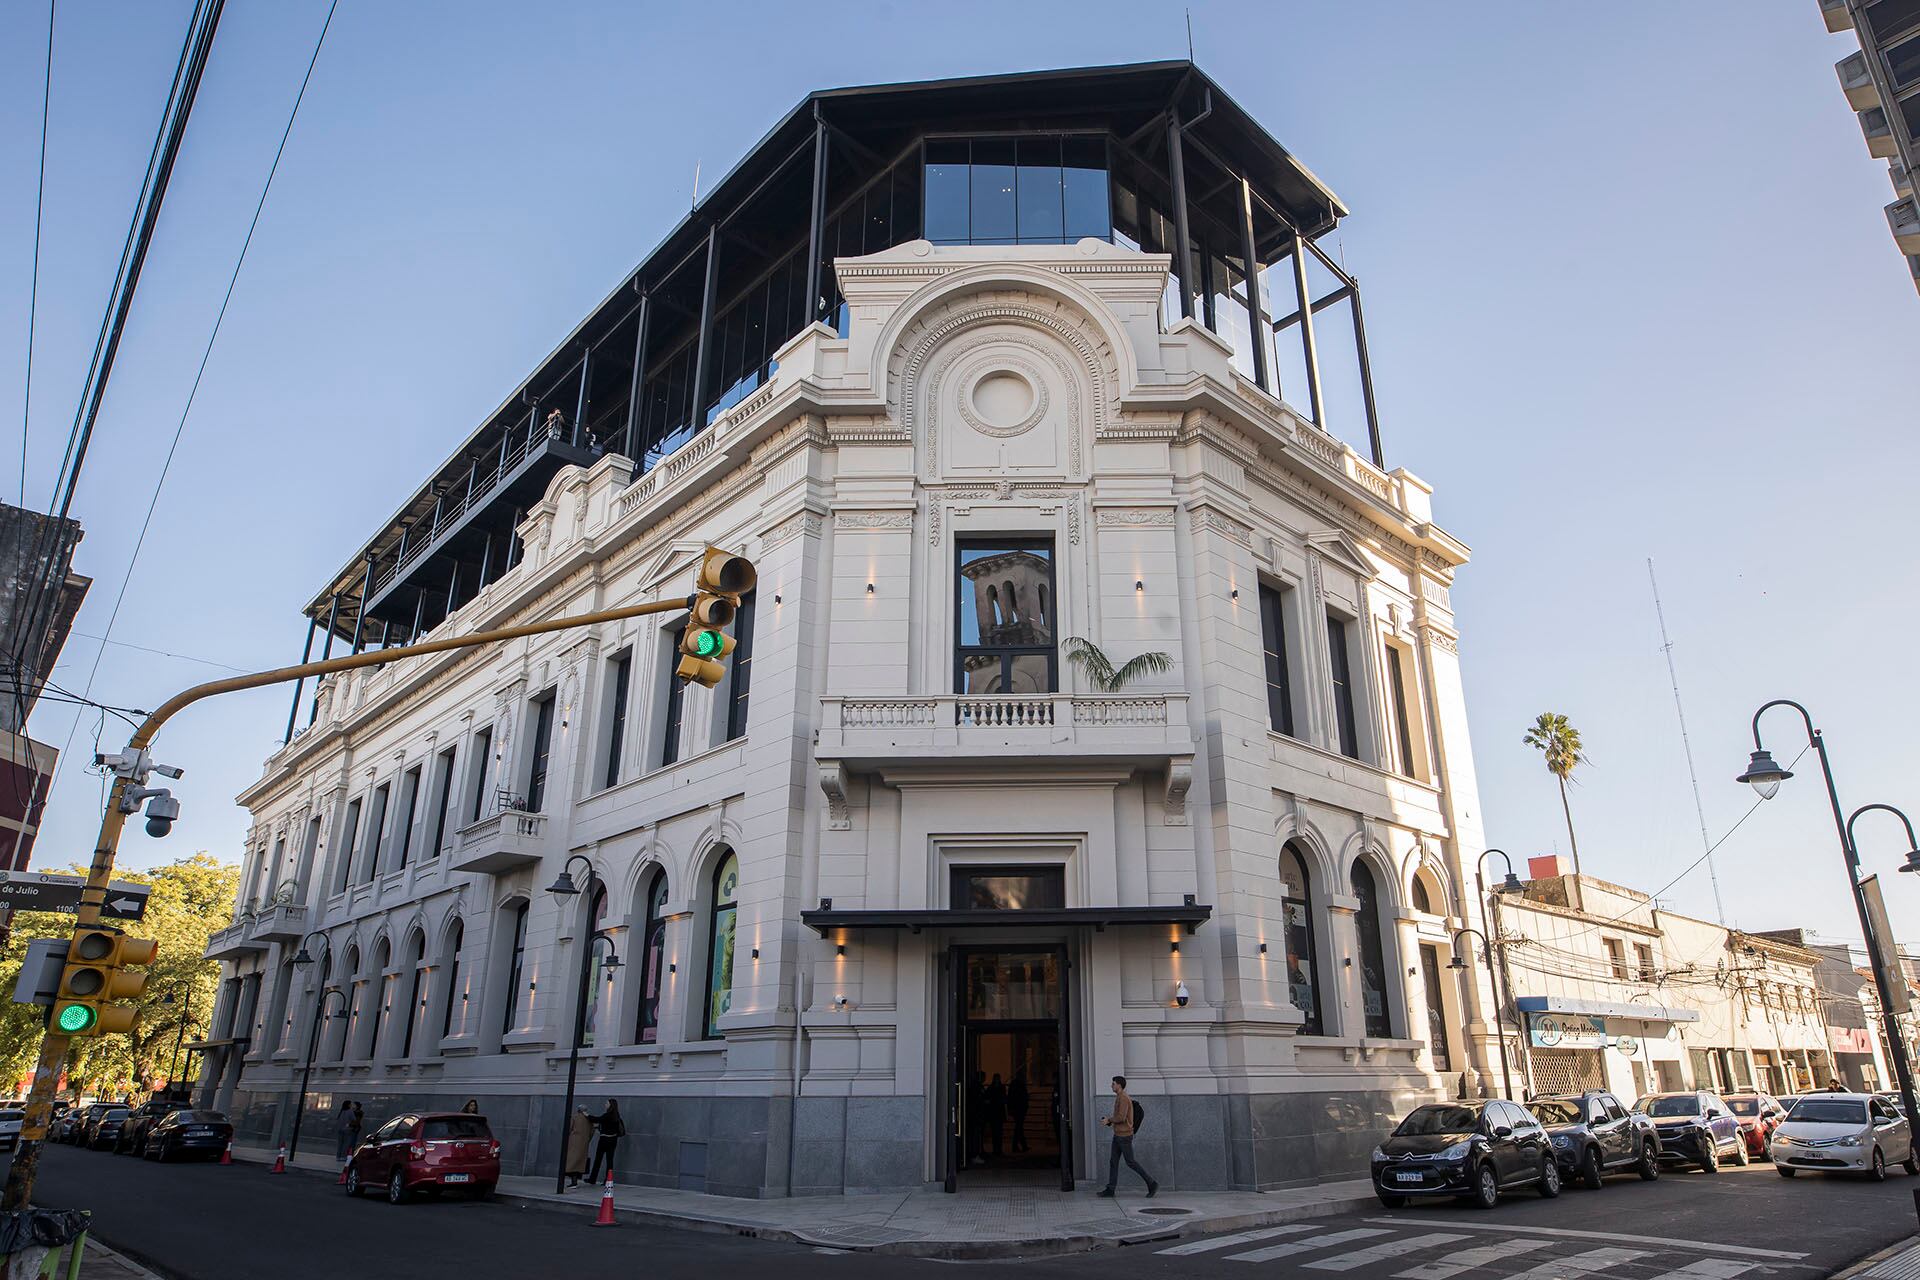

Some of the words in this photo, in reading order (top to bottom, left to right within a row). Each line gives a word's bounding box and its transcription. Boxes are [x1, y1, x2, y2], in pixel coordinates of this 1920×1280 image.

[2, 885, 14, 893] de
[16, 886, 39, 895] Julio
[56, 905, 74, 913] 1100
